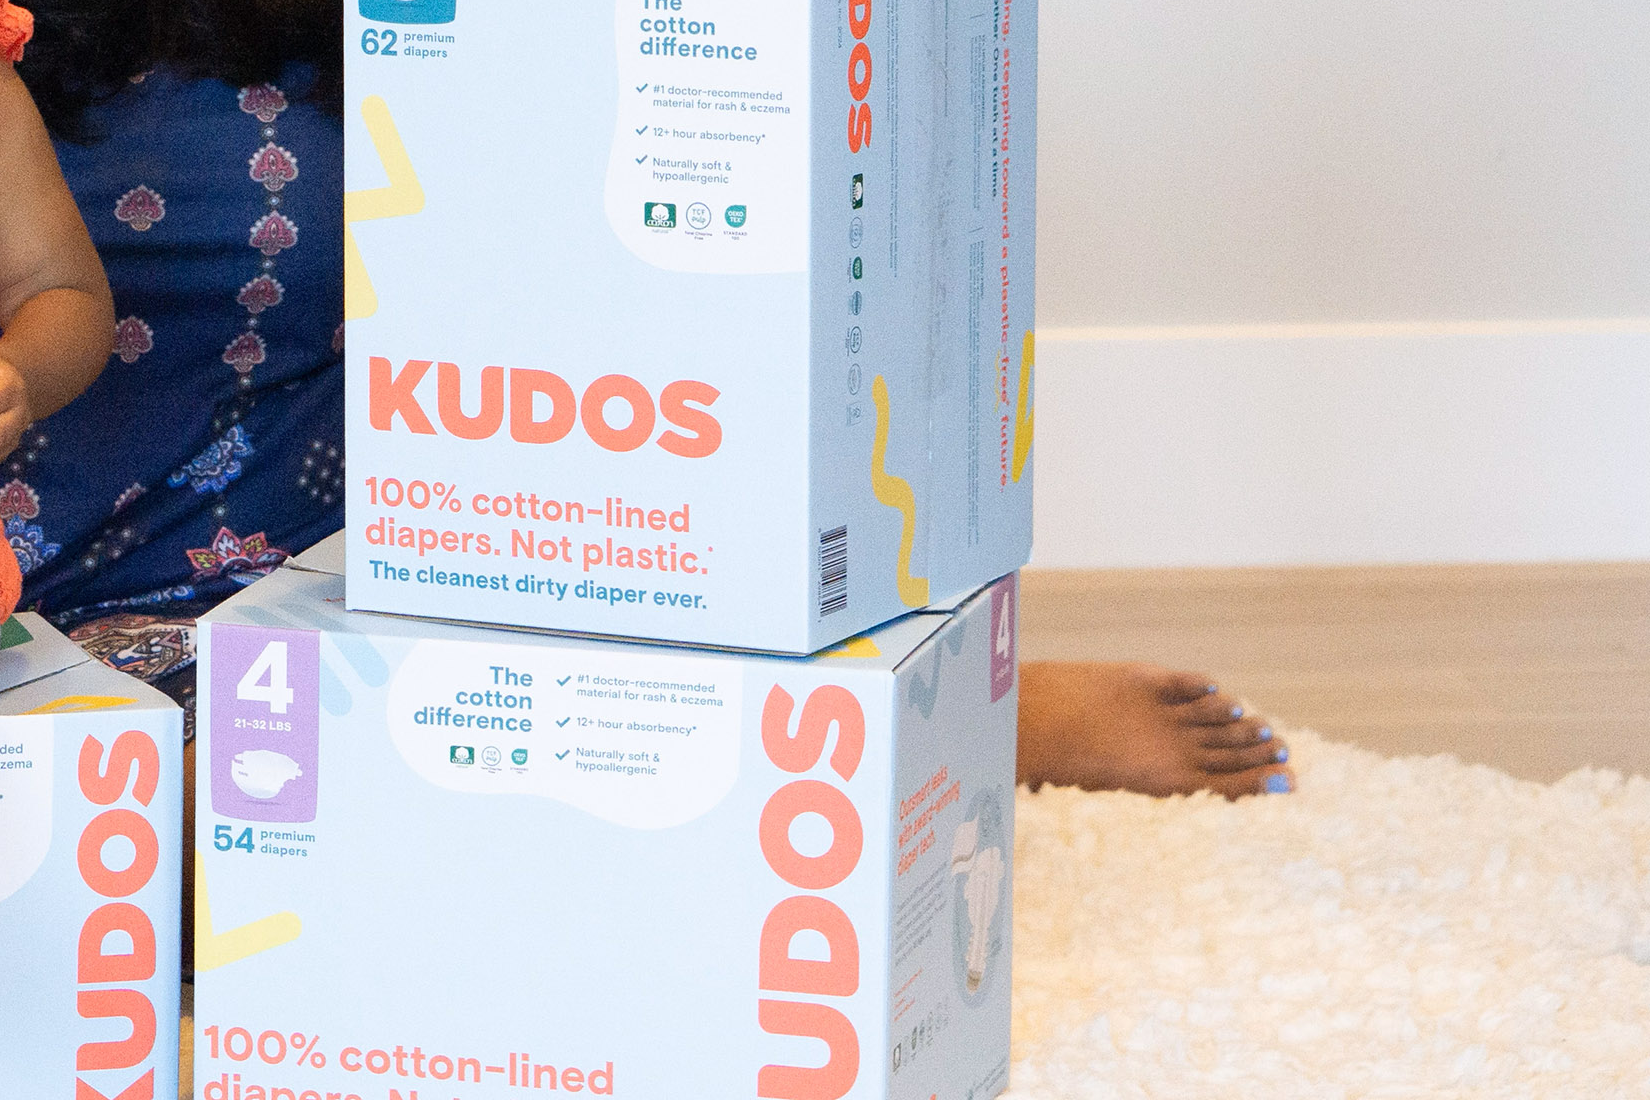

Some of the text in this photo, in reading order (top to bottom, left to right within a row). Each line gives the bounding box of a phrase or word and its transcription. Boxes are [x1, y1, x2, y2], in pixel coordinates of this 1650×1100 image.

[640, 16, 716, 37] cotton
[360, 28, 398, 57] 62
[404, 31, 456, 45] premium
[404, 45, 448, 60] diapers
[640, 37, 758, 62] difference
[653, 84, 783, 101] #1 doctor-recommended
[653, 98, 791, 114] material for rash & eczema
[653, 127, 670, 137] 12+
[672, 128, 697, 139] hour
[653, 157, 732, 171] Naturally soft &
[652, 170, 729, 185] hypoallergenic
[1001, 158, 1011, 240] toward
[368, 356, 723, 459] KUDOS
[365, 476, 690, 533] 100% cotton-lined
[365, 518, 501, 560] diapers.
[510, 530, 573, 564] Not
[369, 559, 708, 610] The cleanest dirty diaper ever.
[995, 592, 1011, 660] 4
[236, 640, 295, 715] 4
[489, 665, 533, 687] The
[577, 674, 716, 693] #1 doctor-recommended
[455, 690, 533, 710] cotton
[576, 687, 724, 707] material for rash & eczema
[233, 717, 292, 732] 21-32 LBS
[413, 706, 533, 733] difference
[576, 717, 595, 727] 12+
[597, 718, 623, 730] hour
[576, 747, 660, 763] Naturally soft &
[575, 760, 657, 775] hypoallergenic
[212, 824, 256, 855] 54
[260, 828, 316, 845] premium
[260, 843, 308, 858] diapers
[204, 1025, 327, 1069] 100%
[339, 1045, 614, 1096] cotton-lined
